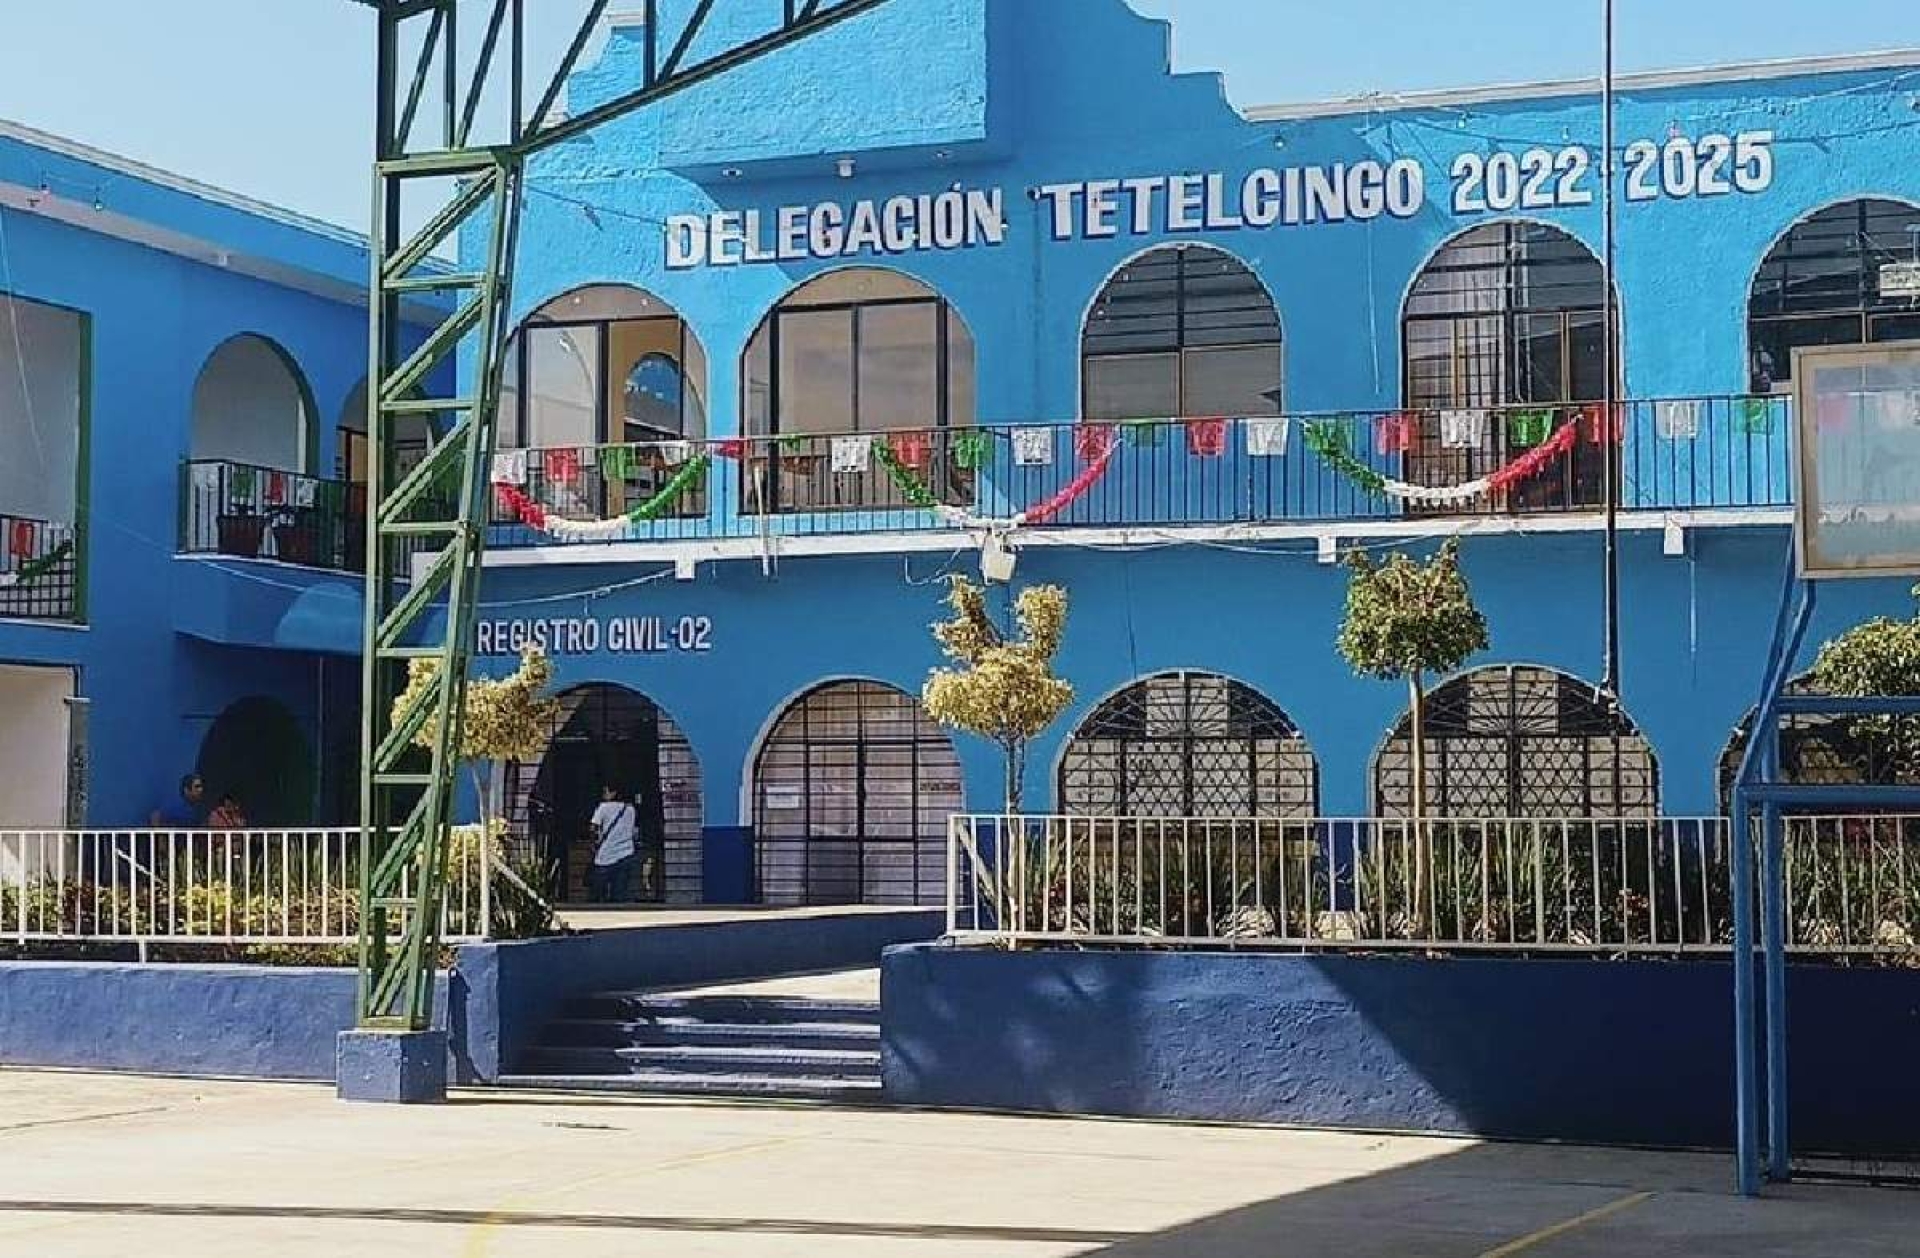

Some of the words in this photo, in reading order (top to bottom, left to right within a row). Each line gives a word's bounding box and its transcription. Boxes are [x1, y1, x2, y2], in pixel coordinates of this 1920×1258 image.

[665, 181, 1003, 269] DELEGACIÓN
[1040, 157, 1424, 238] TETELCINGO
[477, 618, 600, 653] REGISTRO
